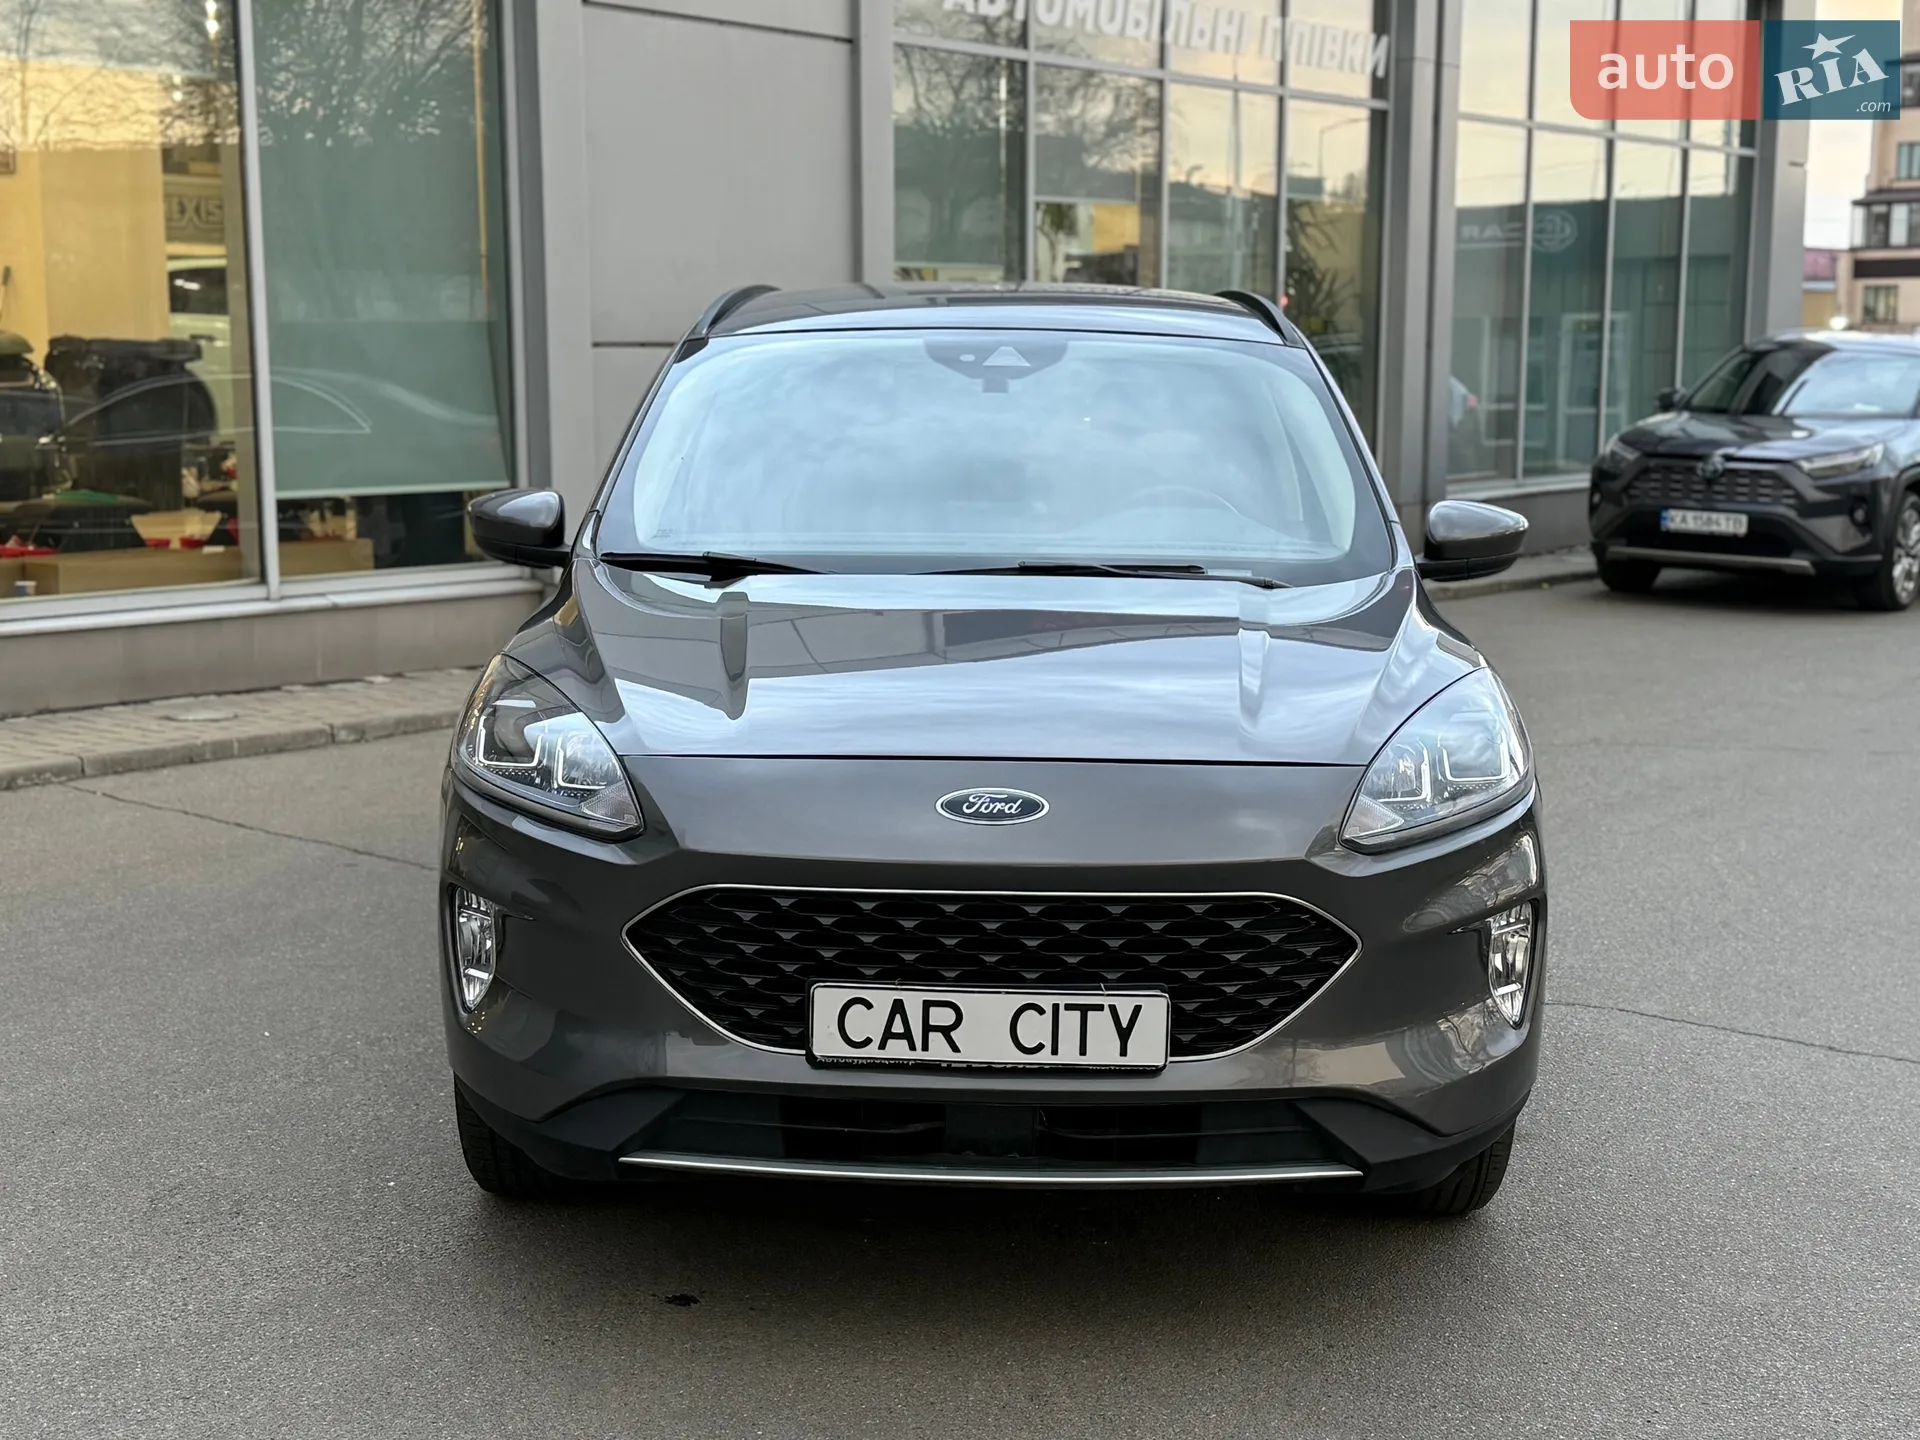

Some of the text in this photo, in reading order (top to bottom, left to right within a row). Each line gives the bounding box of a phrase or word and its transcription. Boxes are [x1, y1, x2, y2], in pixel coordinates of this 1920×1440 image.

[942, 0, 1247, 54] ОМОБІЛЬНІ
[962, 793, 1023, 814] Ford
[837, 996, 1143, 1057] CAR CITY
